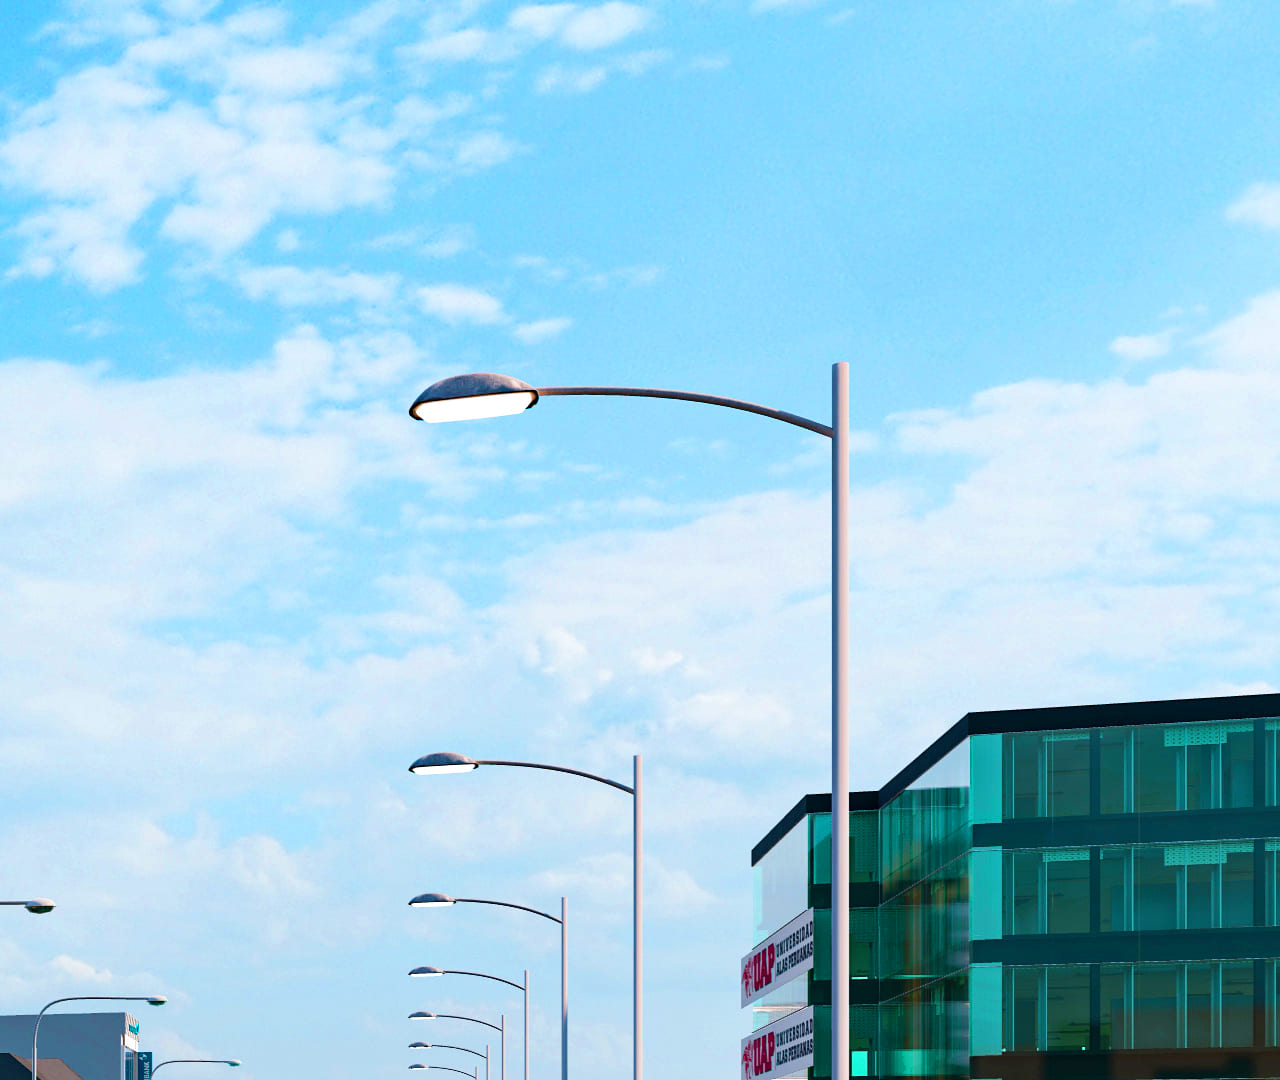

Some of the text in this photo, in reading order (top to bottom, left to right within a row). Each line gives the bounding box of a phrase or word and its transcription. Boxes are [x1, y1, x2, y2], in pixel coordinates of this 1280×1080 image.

[776, 920, 813, 958] UNIVERSIDAD
[754, 943, 775, 992] UAP
[754, 1031, 775, 1076] UAP
[776, 1018, 813, 1048] UNIVERSIDAD
